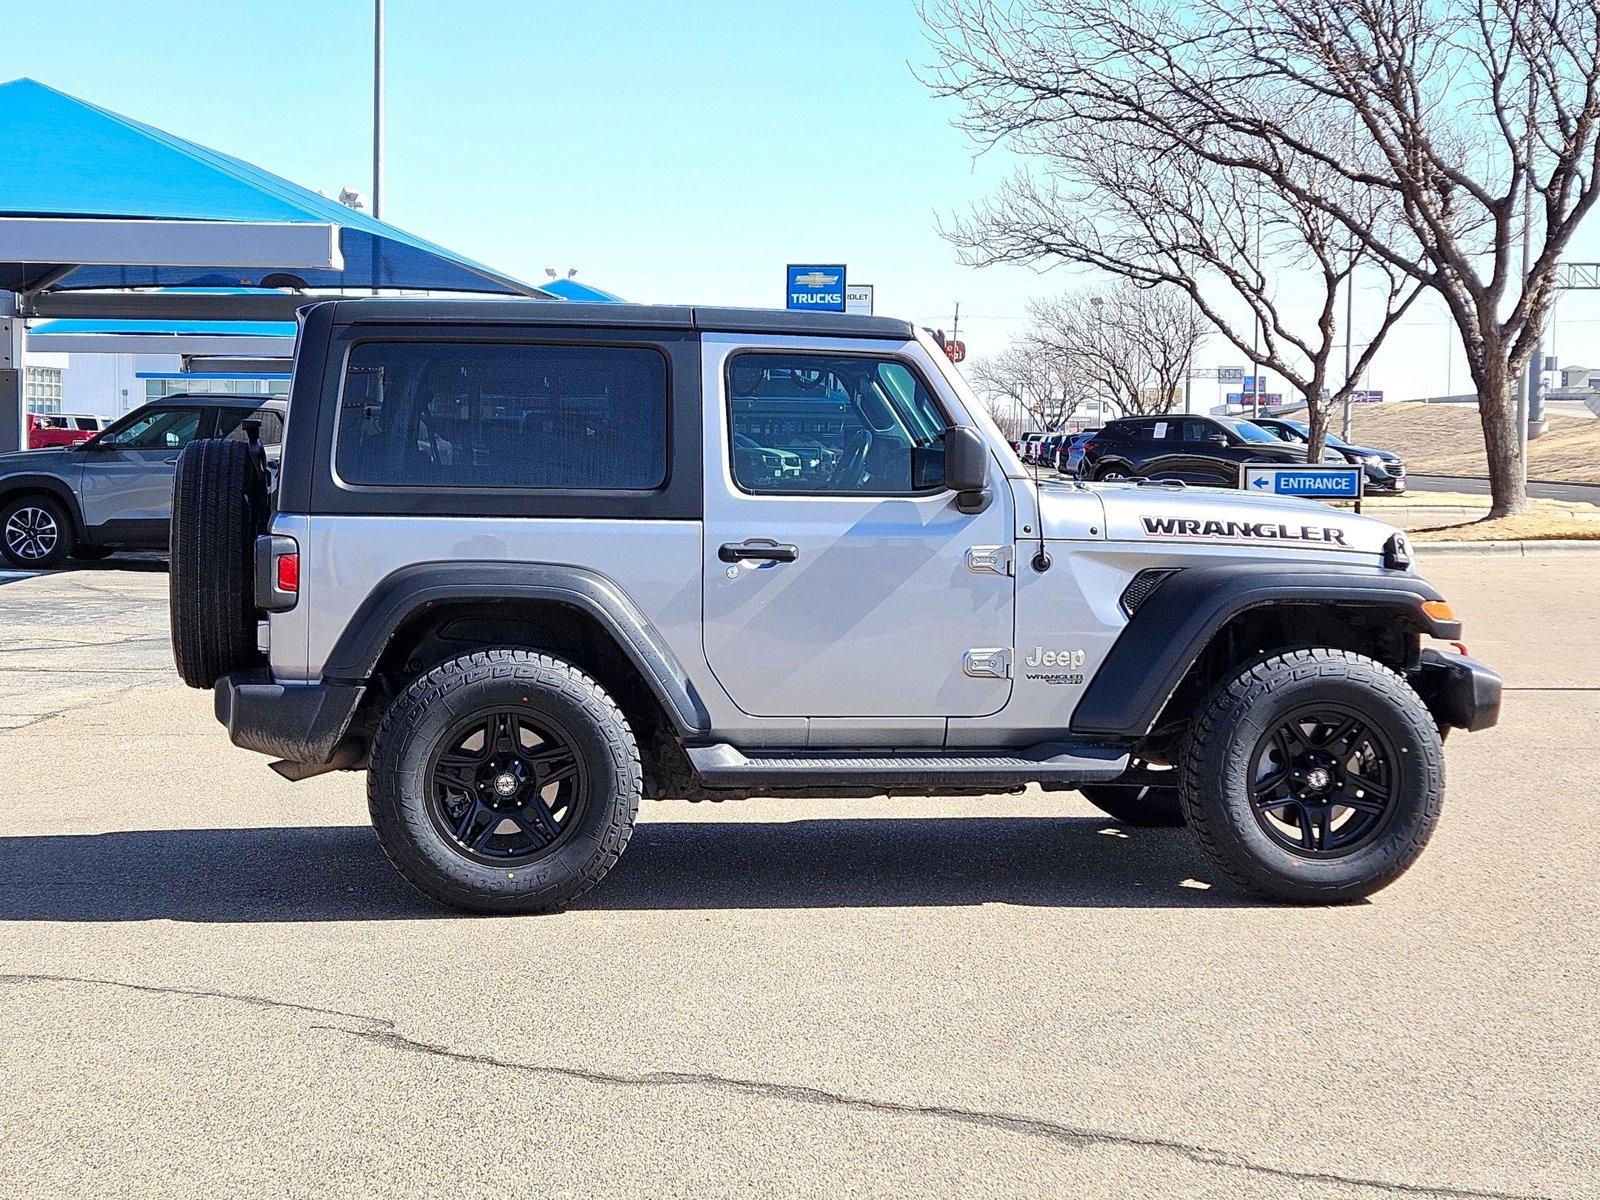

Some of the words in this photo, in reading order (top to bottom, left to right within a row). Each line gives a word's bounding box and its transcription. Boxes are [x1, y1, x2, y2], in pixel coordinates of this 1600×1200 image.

[791, 293, 841, 304] TRUCKS
[1280, 477, 1350, 490] ENTRANCE
[1142, 517, 1350, 547] WRANGLER
[1025, 646, 1085, 670] Jeep
